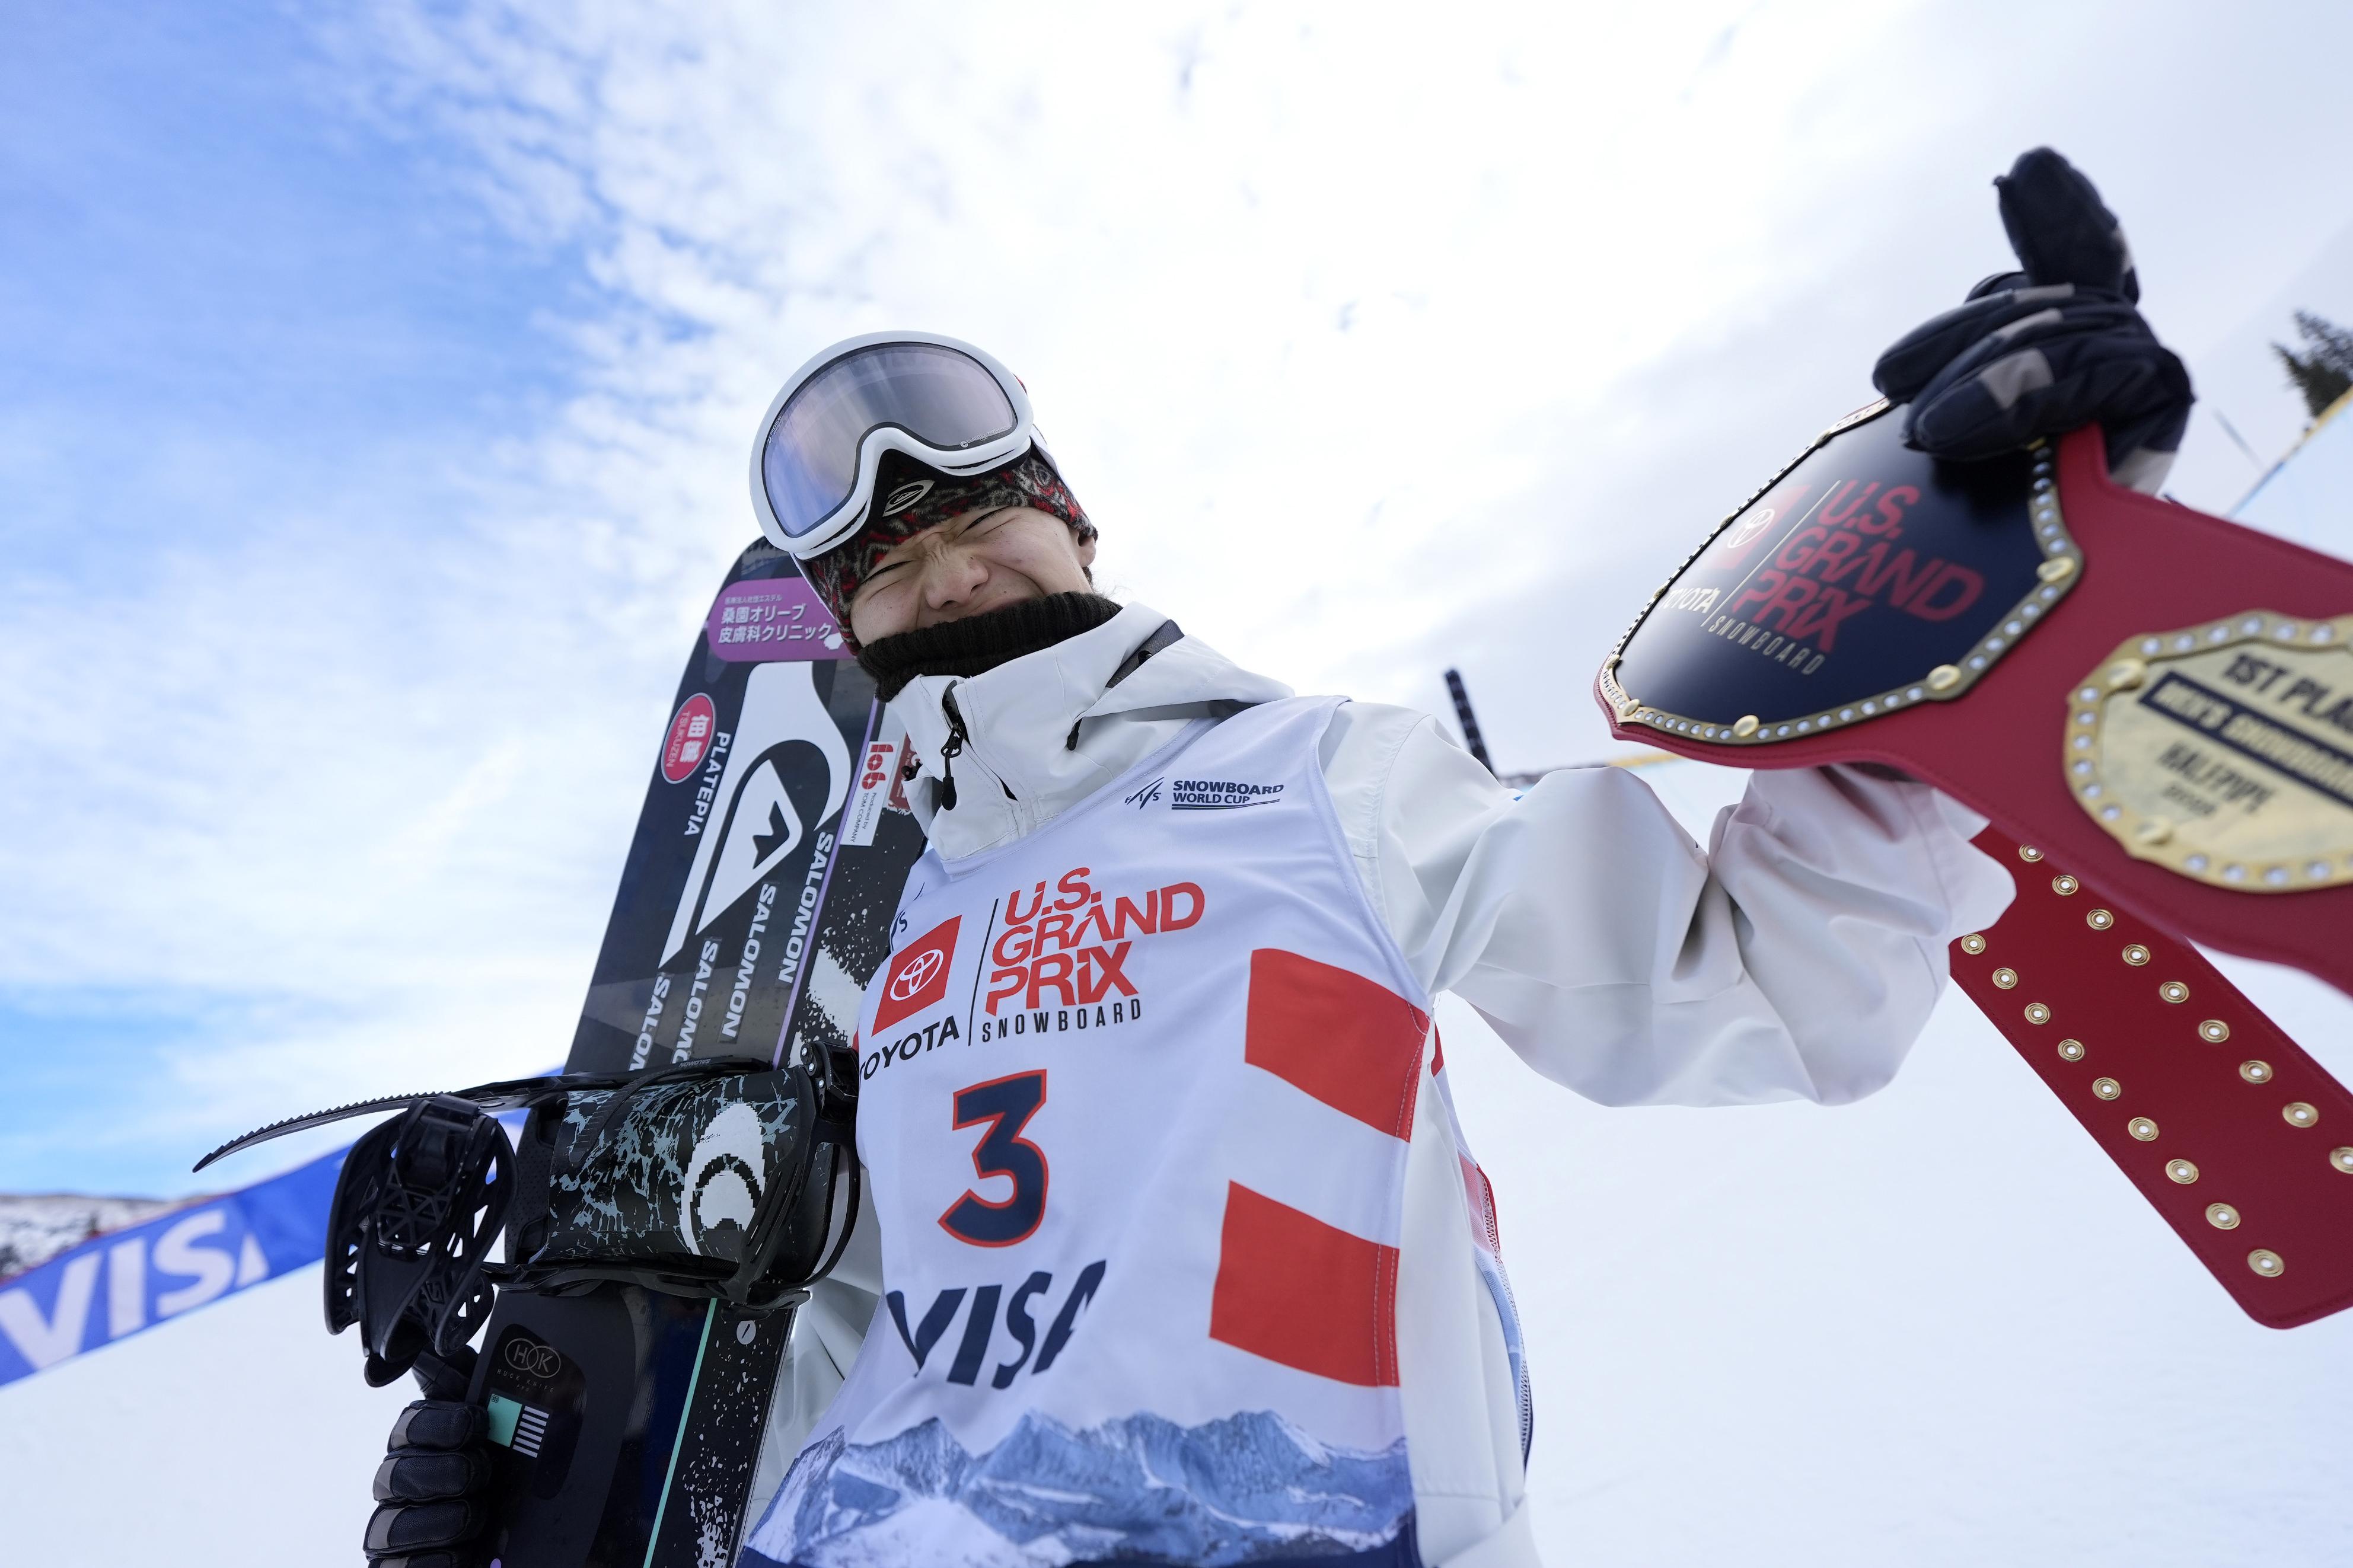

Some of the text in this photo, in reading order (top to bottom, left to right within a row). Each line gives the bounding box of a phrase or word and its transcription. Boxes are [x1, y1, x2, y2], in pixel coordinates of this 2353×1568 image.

[1818, 479, 1921, 540] U.S.
[1659, 587, 1721, 614] TOYOTA
[1774, 525, 1985, 621] GRAND
[718, 622, 832, 644] 皮膚科クリニック
[721, 603, 806, 624] 桑園オリーブ
[1732, 569, 1873, 653] PRIX
[1708, 615, 1826, 675] SNOWBOARD
[684, 732, 731, 835] PLATEPIA
[1173, 780, 1284, 795] SNOWBOARD
[1173, 793, 1250, 803] WORLD CUP
[850, 793, 869, 842] TOM COMPANY
[778, 831, 834, 983] SALOMON
[991, 882, 1205, 967] GRAND
[1005, 867, 1101, 926] U.S.
[722, 883, 777, 1038] SALOMON
[984, 940, 1139, 1017] PRIX
[860, 1015, 959, 1085] OYOTA
[982, 998, 1141, 1043] SNOWBOARD
[678, 1058, 712, 1067] SALOMON
[937, 1069, 1049, 1248] 3
[497, 1368, 554, 1393] HUCK KNIFE
